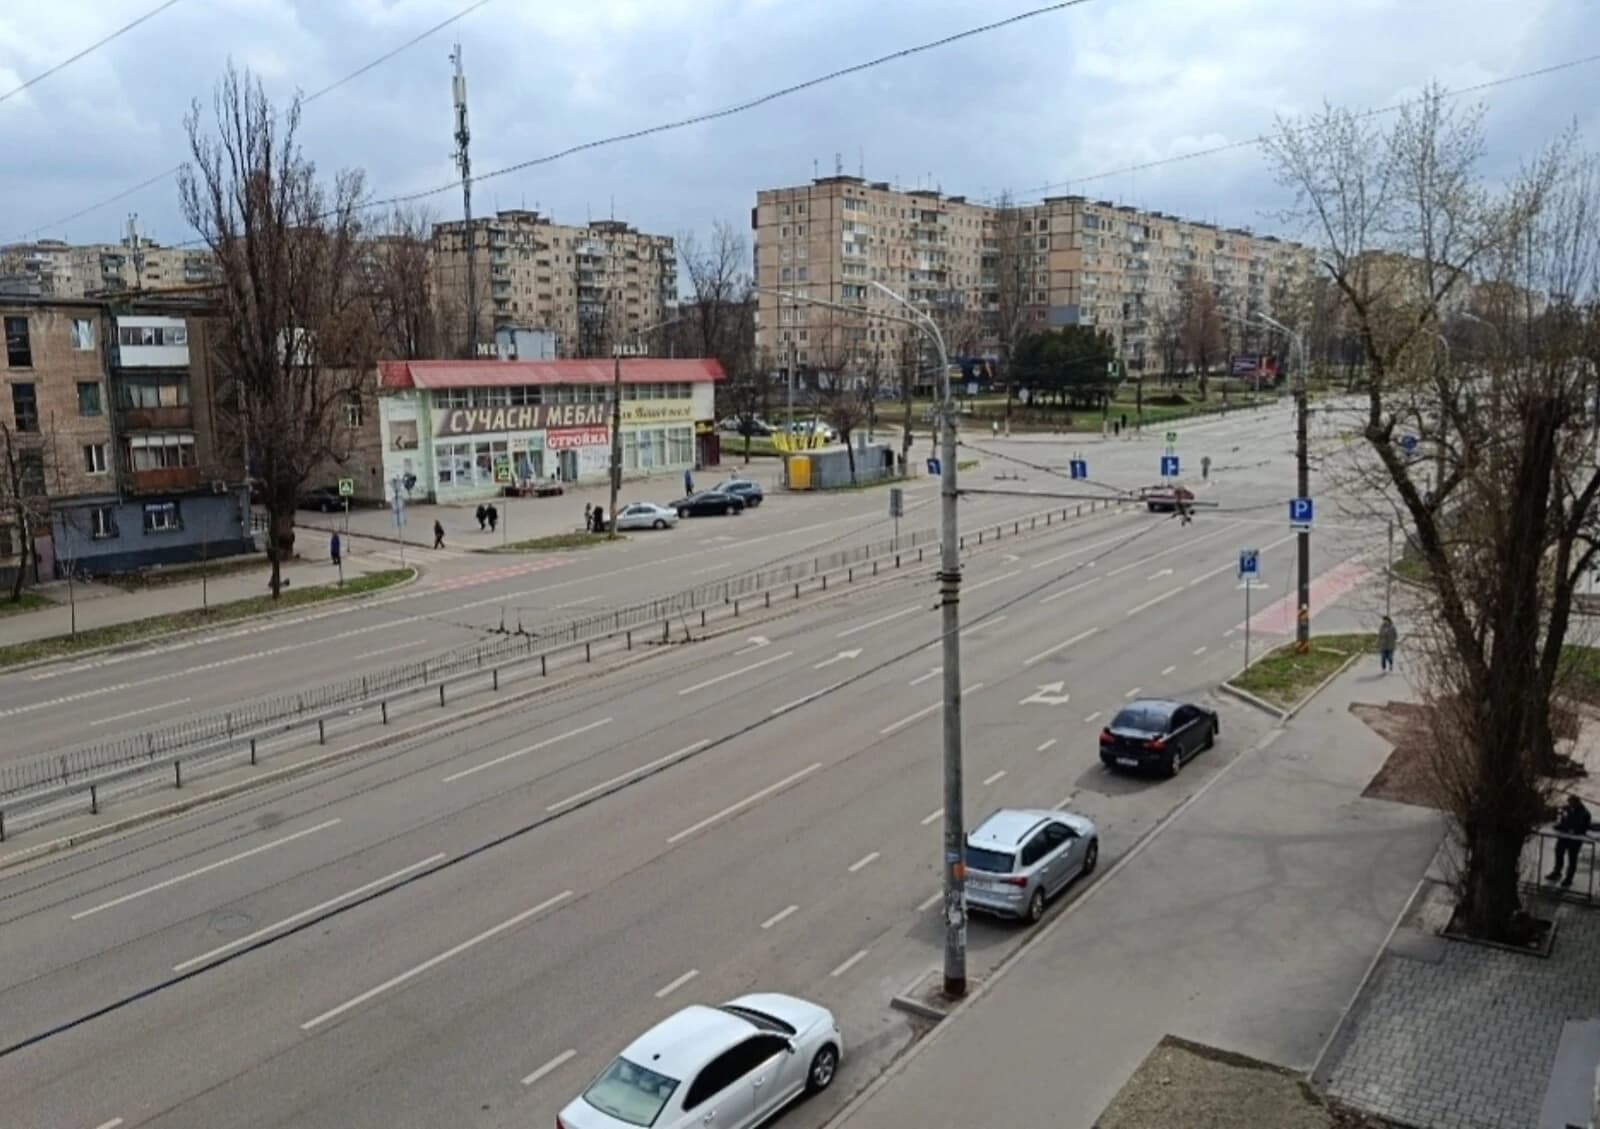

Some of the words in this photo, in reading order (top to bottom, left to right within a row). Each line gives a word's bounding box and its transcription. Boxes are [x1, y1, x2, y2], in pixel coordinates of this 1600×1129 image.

[451, 406, 539, 432] СУЧАСНІ
[547, 403, 604, 426] МЕБЛІ
[1295, 500, 1308, 517] P
